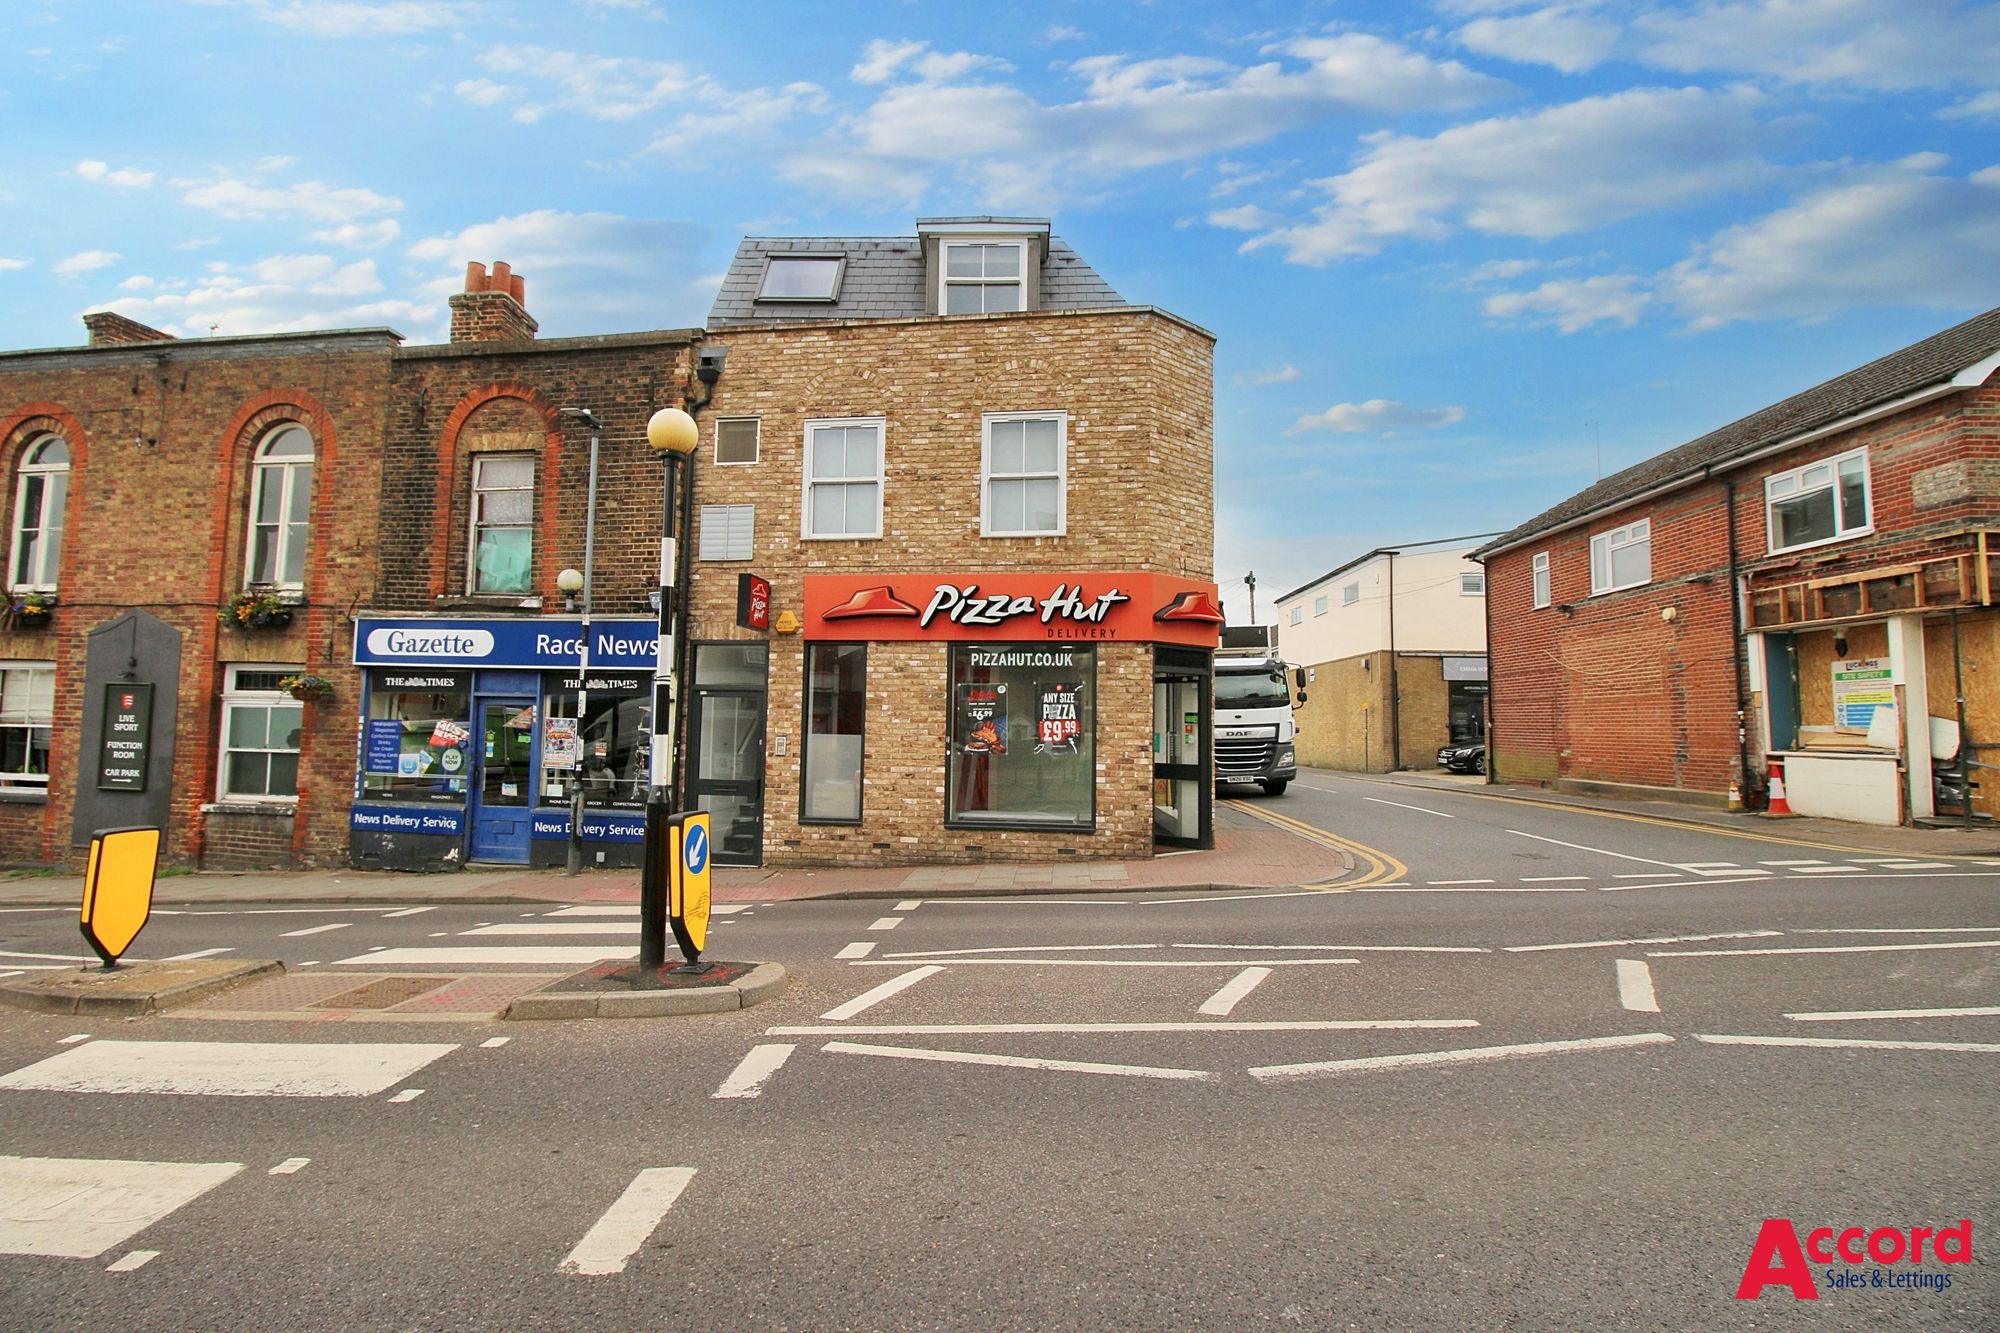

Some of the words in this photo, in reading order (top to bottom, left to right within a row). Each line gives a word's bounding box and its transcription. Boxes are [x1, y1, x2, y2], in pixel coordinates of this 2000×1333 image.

[752, 597, 766, 611] Pizza
[920, 584, 1036, 629] Pizza
[1039, 583, 1131, 624] Hut
[1047, 629, 1116, 638] DELIVERY
[387, 631, 474, 654] Gazette
[598, 635, 658, 655] News
[971, 653, 1073, 667] PIZZAHUT.CO.UK
[385, 677, 405, 686] THE
[426, 678, 455, 686] TIMES
[607, 680, 637, 689] TIMES
[1043, 692, 1058, 703] ANY
[1059, 692, 1075, 703] SIZE
[118, 714, 136, 722] LIVE
[1043, 704, 1076, 720] PZZA
[114, 723, 139, 731] SPORT
[1043, 721, 1077, 742] £9.99
[106, 741, 143, 749] FUNCTION
[113, 751, 135, 759] ROOM
[104, 768, 120, 777] CAR
[120, 768, 140, 777] PARK
[354, 813, 380, 825] News
[383, 814, 421, 829] Delivery
[423, 816, 457, 830] Service
[534, 822, 562, 833] News
[608, 824, 645, 836] Service
